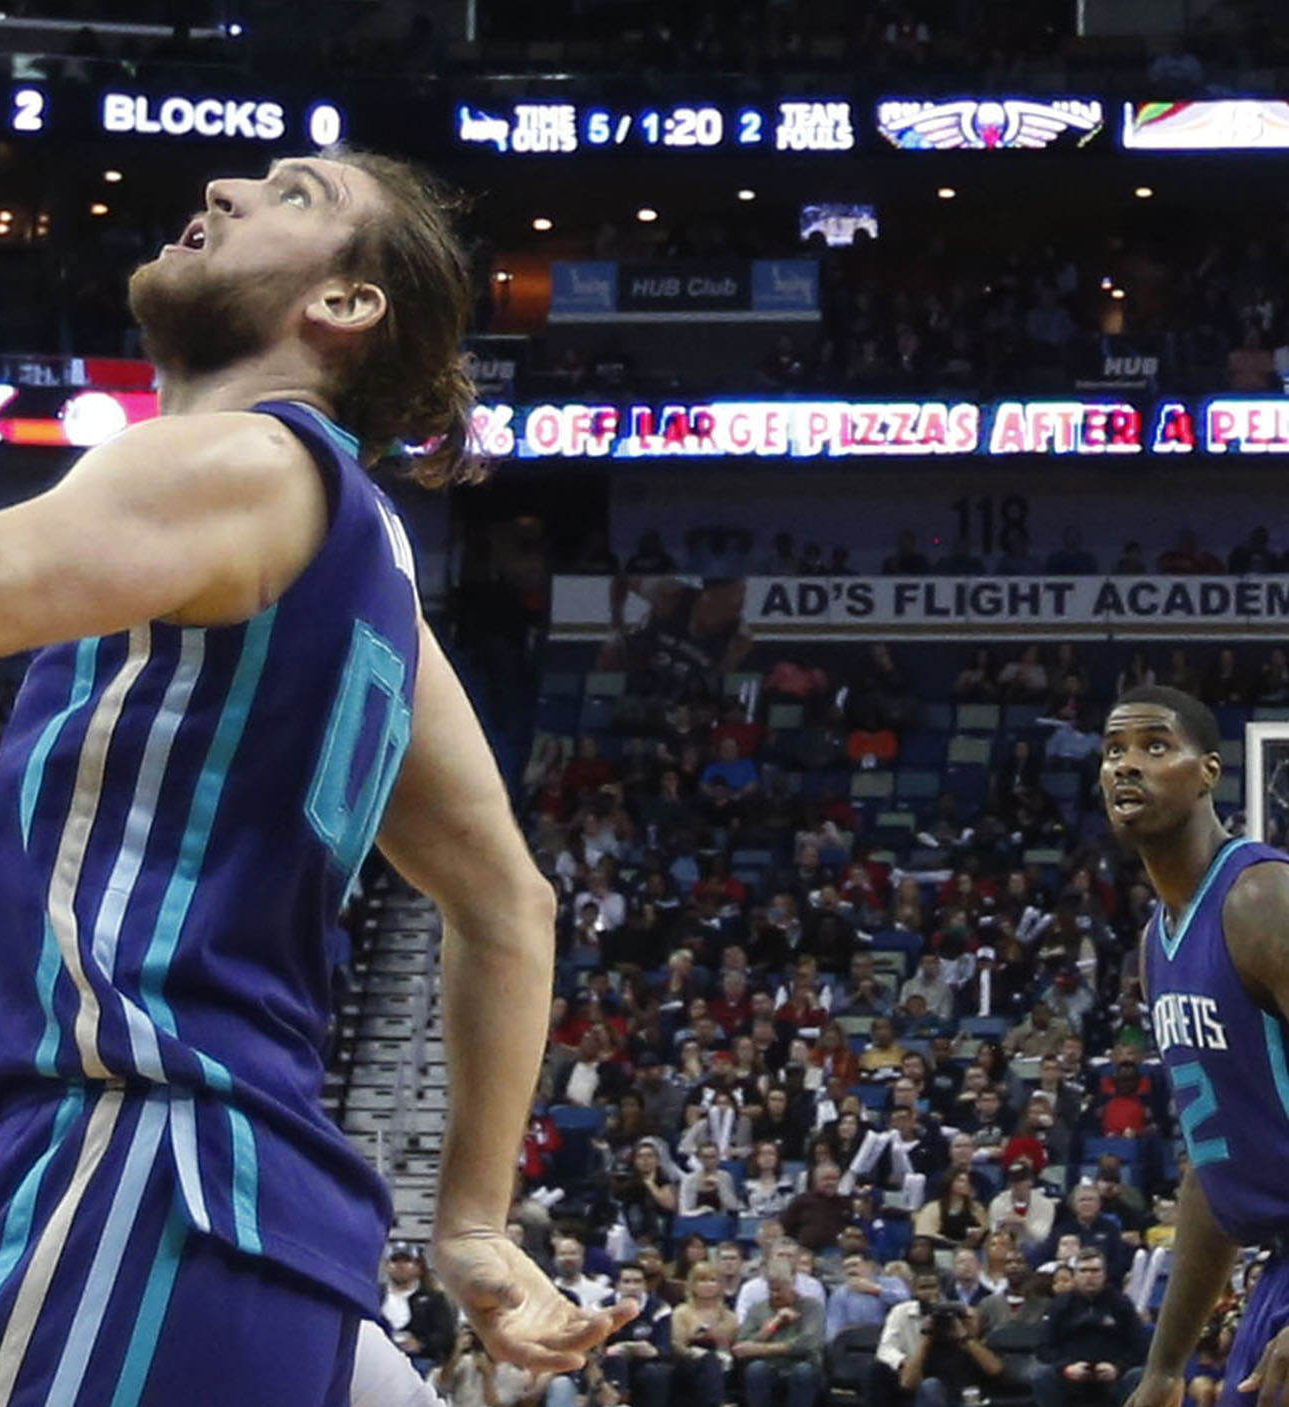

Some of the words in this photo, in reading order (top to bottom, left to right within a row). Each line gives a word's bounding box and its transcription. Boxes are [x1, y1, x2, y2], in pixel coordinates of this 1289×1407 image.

[13, 90, 43, 131] 2
[103, 93, 285, 139] BLOCKS
[311, 105, 341, 146] 0
[514, 104, 577, 129] TIME
[779, 102, 850, 127] TEAM
[511, 128, 579, 153] OUTS
[738, 112, 763, 144] 2
[776, 125, 855, 151] FOULS
[632, 279, 681, 297] HUB
[687, 277, 738, 297] Club
[1104, 356, 1159, 376] HUB
[526, 404, 619, 456] OFF
[630, 404, 790, 456] LARGE
[798, 404, 980, 455] PIZZAS
[991, 402, 1141, 454] AFTER
[1153, 403, 1194, 453] A
[951, 494, 1030, 557] 118
[893, 581, 1076, 618] FLIGHT
